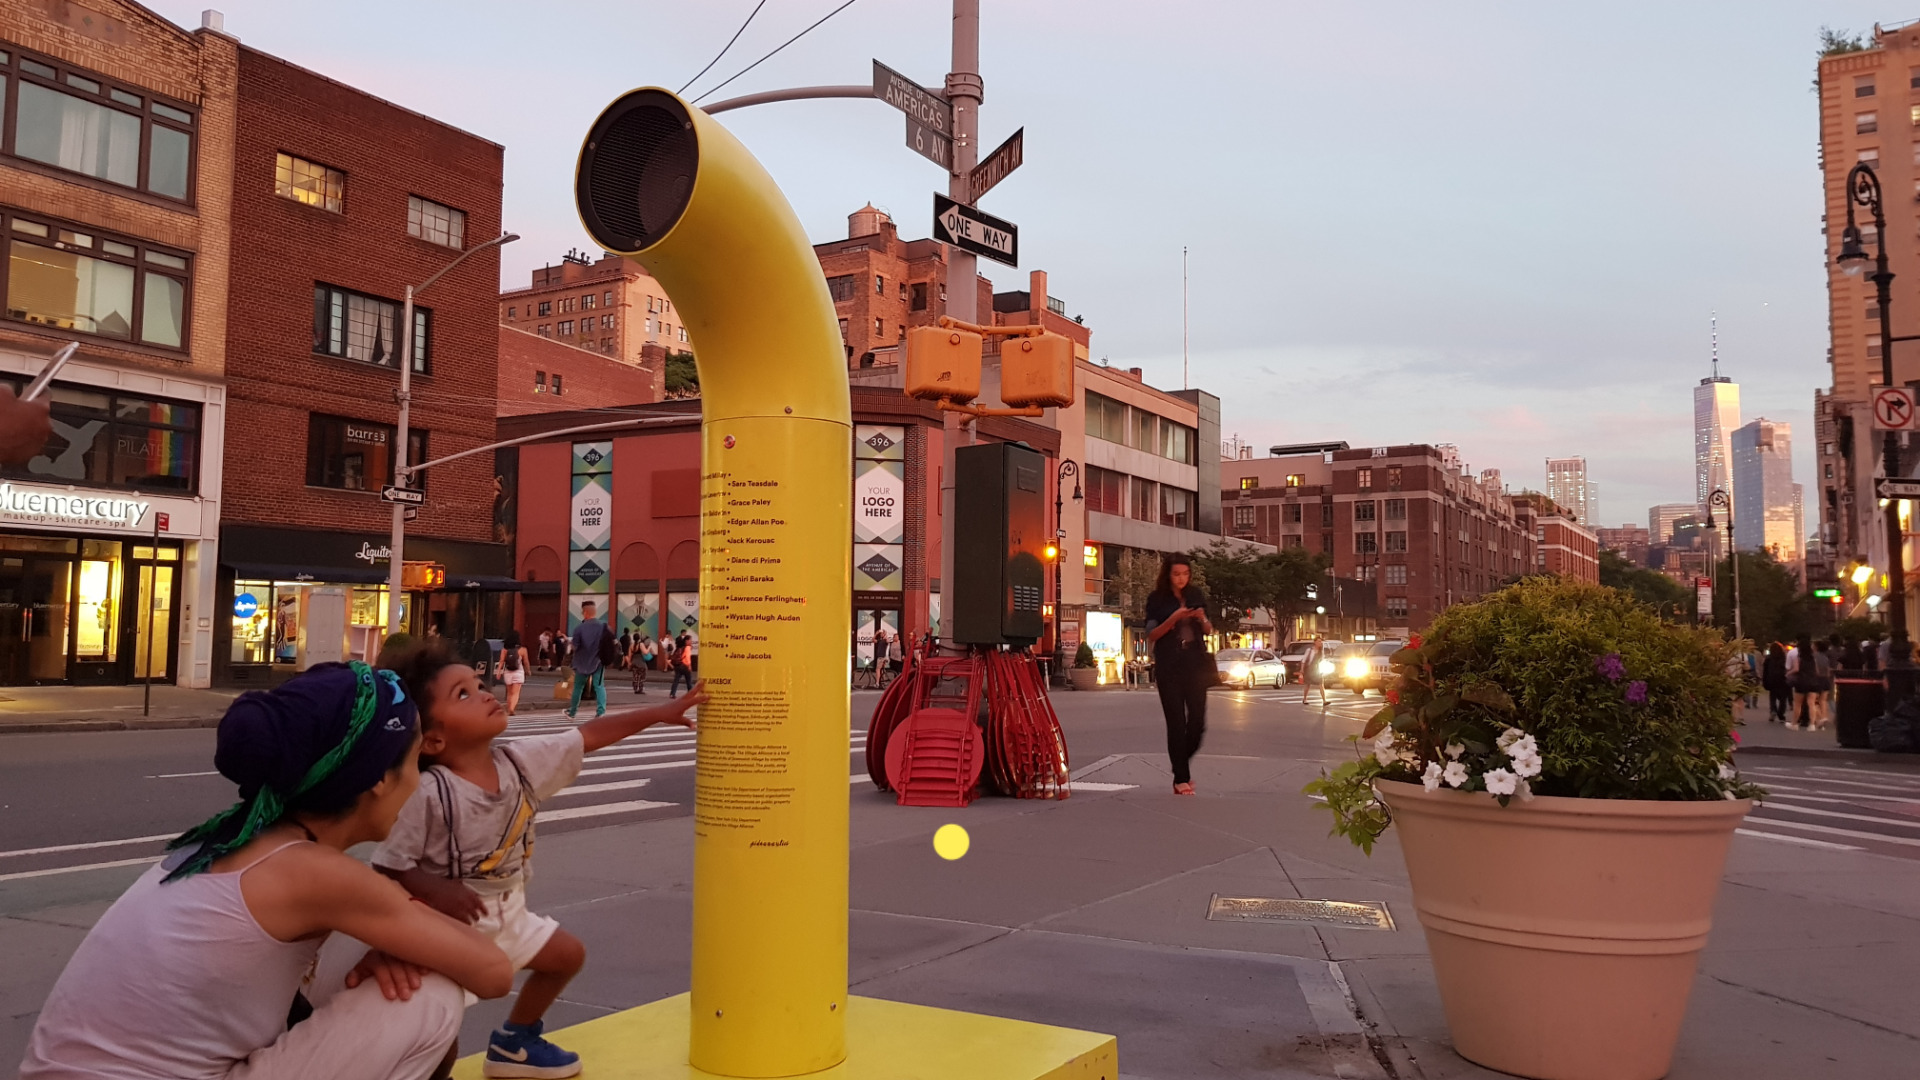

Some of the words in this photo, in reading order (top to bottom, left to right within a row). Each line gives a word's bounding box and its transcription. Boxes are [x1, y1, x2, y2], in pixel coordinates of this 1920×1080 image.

[889, 75, 913, 95] AVENUE
[916, 89, 924, 101] OF
[927, 95, 938, 109] THE
[886, 84, 943, 130] AMERICAS
[915, 126, 924, 151] 6
[931, 134, 945, 163] AV
[971, 148, 1009, 202] GREENWICH
[1009, 136, 1021, 171] AV
[948, 213, 972, 238] ONE
[983, 226, 1008, 250] WAY
[871, 437, 890, 447] 396
[585, 453, 600, 462] 396
[387, 489, 401, 498] ONE
[868, 486, 891, 495] YOUR
[1882, 484, 1898, 493] ONE
[1903, 485, 1918, 493] WAY
[0, 484, 149, 526] luemercury
[752, 499, 771, 507] Paley
[862, 497, 895, 507] LOGO
[580, 507, 603, 517] LOGO
[865, 508, 892, 518] HERE
[3, 511, 46, 523] makeup
[55, 515, 100, 526] skincare
[582, 517, 601, 526] HERE
[730, 518, 749, 526] Edgar
[751, 518, 769, 526] Allan
[355, 541, 392, 565] Liquite
[731, 556, 749, 564] Diane
[751, 556, 759, 564] di
[764, 595, 806, 604] Ferlinghetti
[729, 614, 754, 622] Wystan
[755, 614, 776, 622] Hugh
[777, 614, 801, 622] Auden
[730, 633, 745, 641] Hart
[745, 634, 768, 642] Crane
